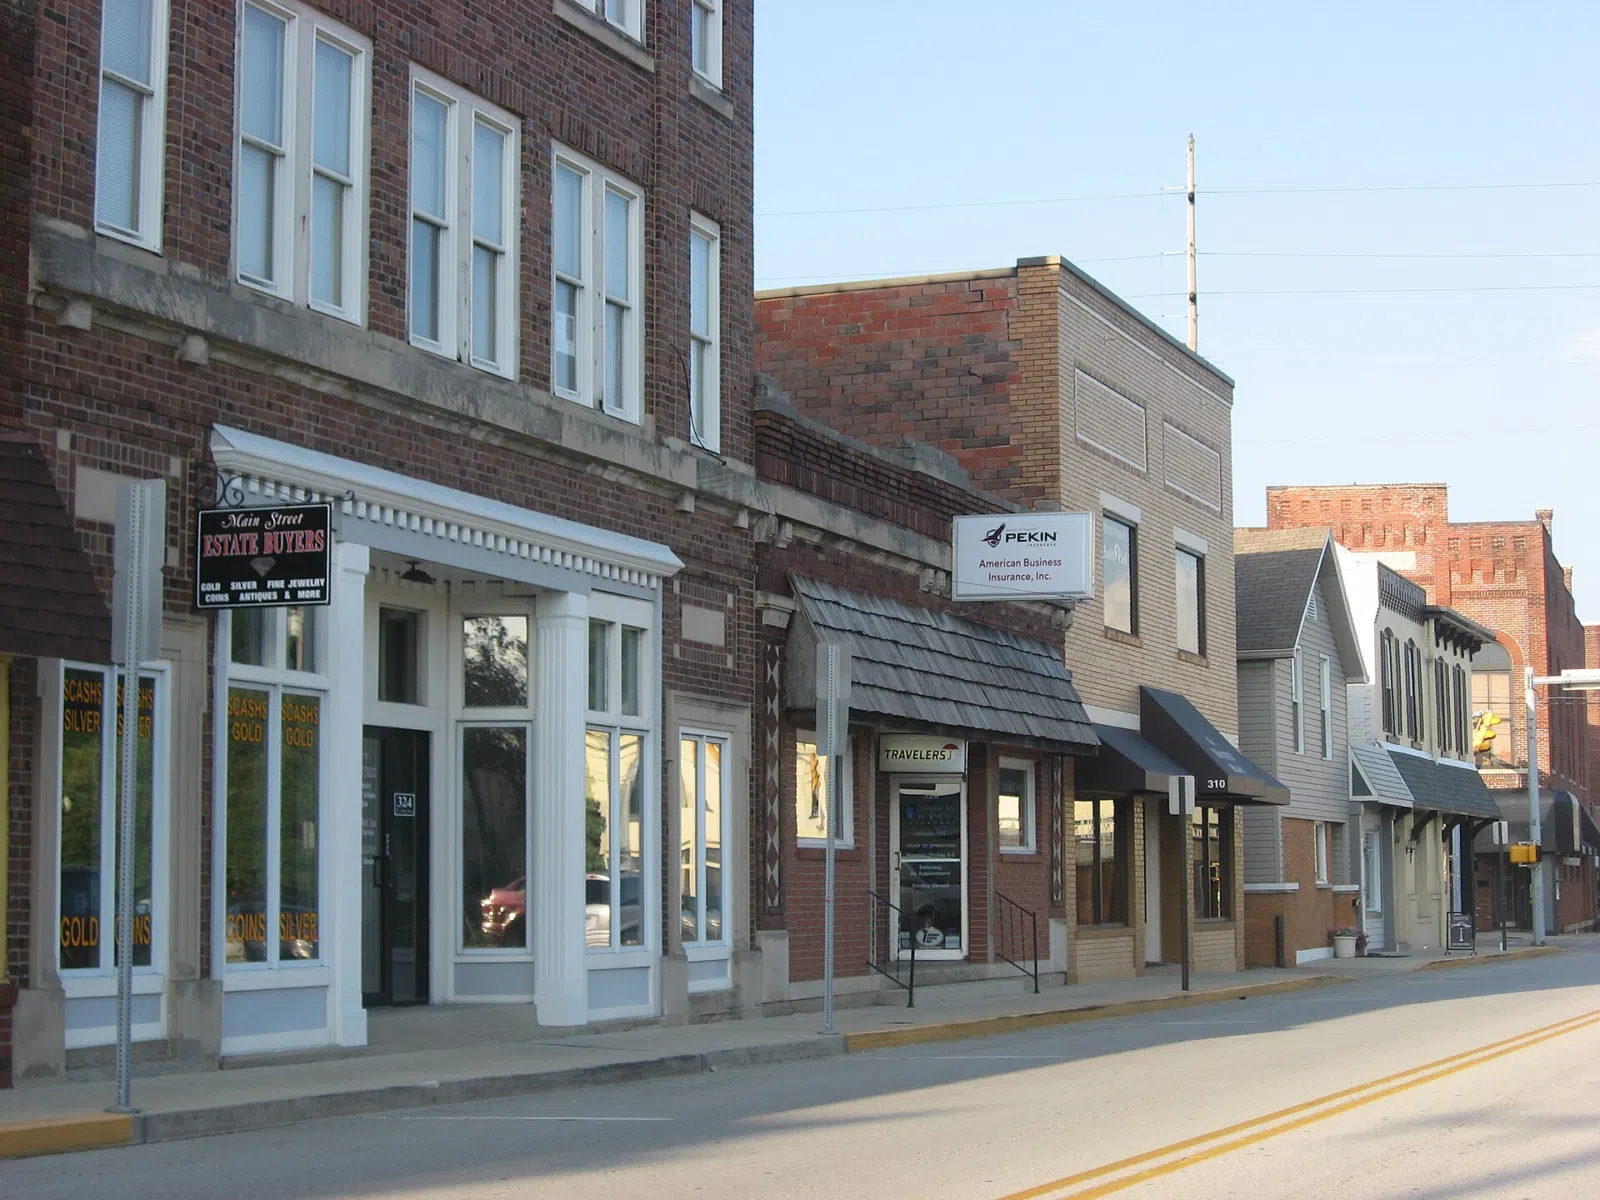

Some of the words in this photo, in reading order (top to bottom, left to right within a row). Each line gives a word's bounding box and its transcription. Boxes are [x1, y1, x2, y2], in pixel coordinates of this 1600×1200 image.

[221, 513, 260, 528] Main
[264, 511, 303, 530] Street
[203, 532, 259, 557] ESTATE
[263, 529, 325, 555] BUYERS
[1005, 531, 1056, 543] PEKIN
[979, 558, 1021, 568] American
[1023, 557, 1062, 567] Business
[988, 572, 1034, 582] Insurance,
[1036, 571, 1052, 580] Inc.
[201, 582, 221, 592] GOLD
[230, 581, 257, 591] SILVER
[267, 580, 285, 589] FINE
[287, 578, 325, 588] JEWELRY
[205, 593, 230, 603] COINS
[239, 591, 278, 602] ANTIQUES
[284, 590, 290, 600] &
[297, 590, 321, 599] MORE
[64, 708, 100, 732] SILVER
[232, 721, 262, 743] GOLD
[285, 727, 313, 747] GOLD
[884, 749, 946, 760] TRAVELERS
[1207, 780, 1226, 788] 310
[397, 796, 412, 808] 324
[61, 915, 99, 948] GOLD
[226, 912, 265, 943] COINS
[280, 911, 317, 942] SILVER
